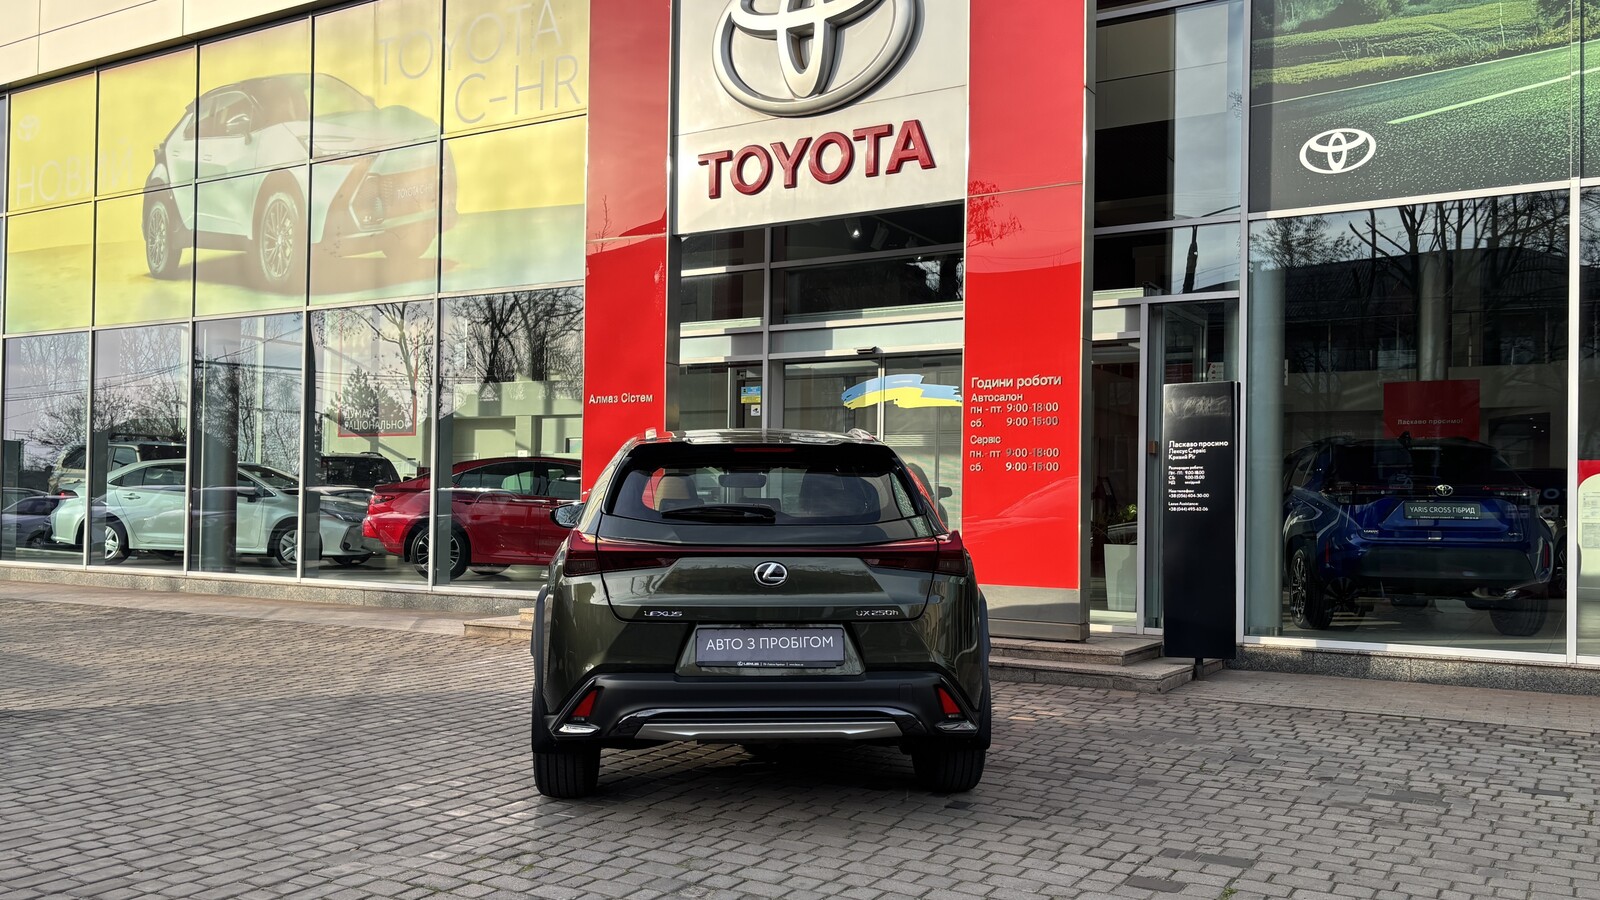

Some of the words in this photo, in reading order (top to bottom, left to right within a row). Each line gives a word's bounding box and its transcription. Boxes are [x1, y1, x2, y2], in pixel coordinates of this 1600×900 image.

[378, 0, 562, 85] TOYOTA
[455, 54, 580, 124] C-HR
[698, 120, 937, 199] TOYOTA
[971, 377, 1014, 390] Години
[1016, 374, 1062, 389] роботи
[589, 394, 618, 404] Алмаз
[621, 393, 653, 403] Сістем
[971, 393, 1023, 402] Автосалон
[970, 418, 984, 428] сб.
[970, 435, 1001, 446] Сервіс
[970, 463, 984, 471] сб.
[706, 638, 743, 651] АВТО
[747, 638, 756, 650] З
[760, 636, 833, 649] ПРОБІГОМ
